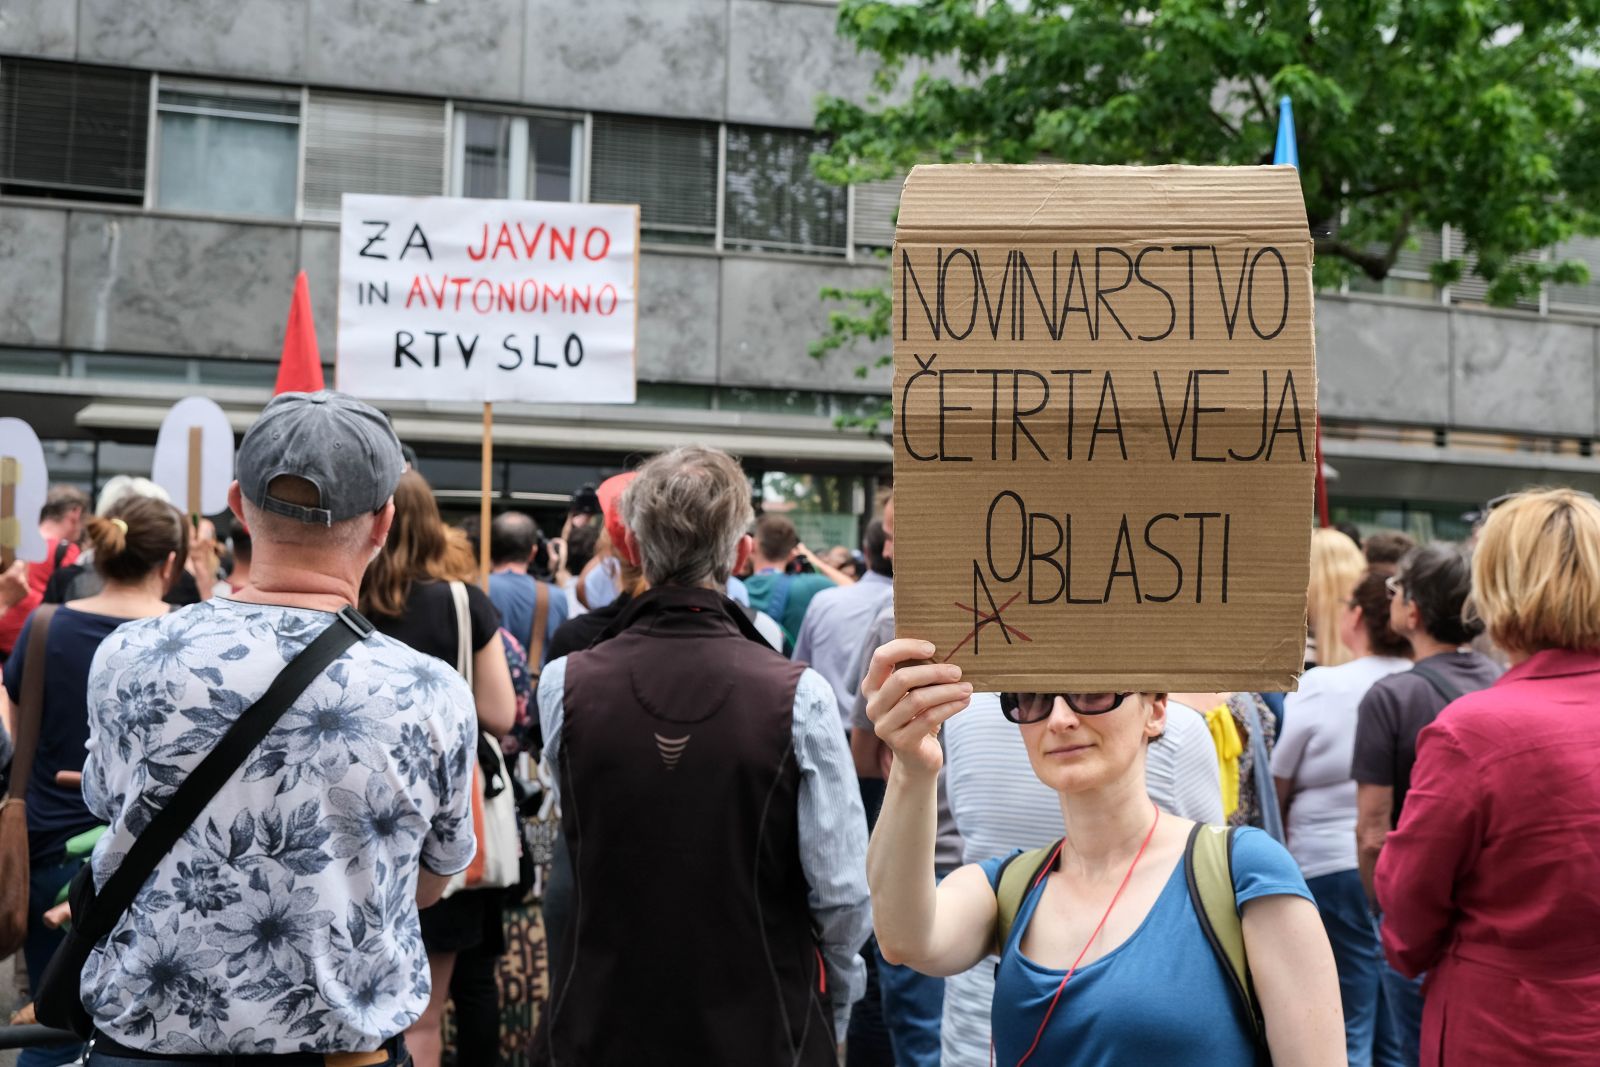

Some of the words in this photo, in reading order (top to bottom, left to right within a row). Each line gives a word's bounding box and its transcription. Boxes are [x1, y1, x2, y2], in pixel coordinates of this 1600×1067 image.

[359, 221, 432, 260] ZA
[467, 222, 611, 262] JAVNO
[358, 281, 389, 305] IN
[405, 274, 618, 316] AVTONOMNO
[902, 245, 1289, 342] NOVINARSTVO
[394, 331, 479, 369] RTV
[498, 333, 584, 371] SLO
[901, 353, 1128, 462] ČETRTA
[1153, 369, 1307, 463] VEJA
[986, 490, 1231, 605] OBLASTI
